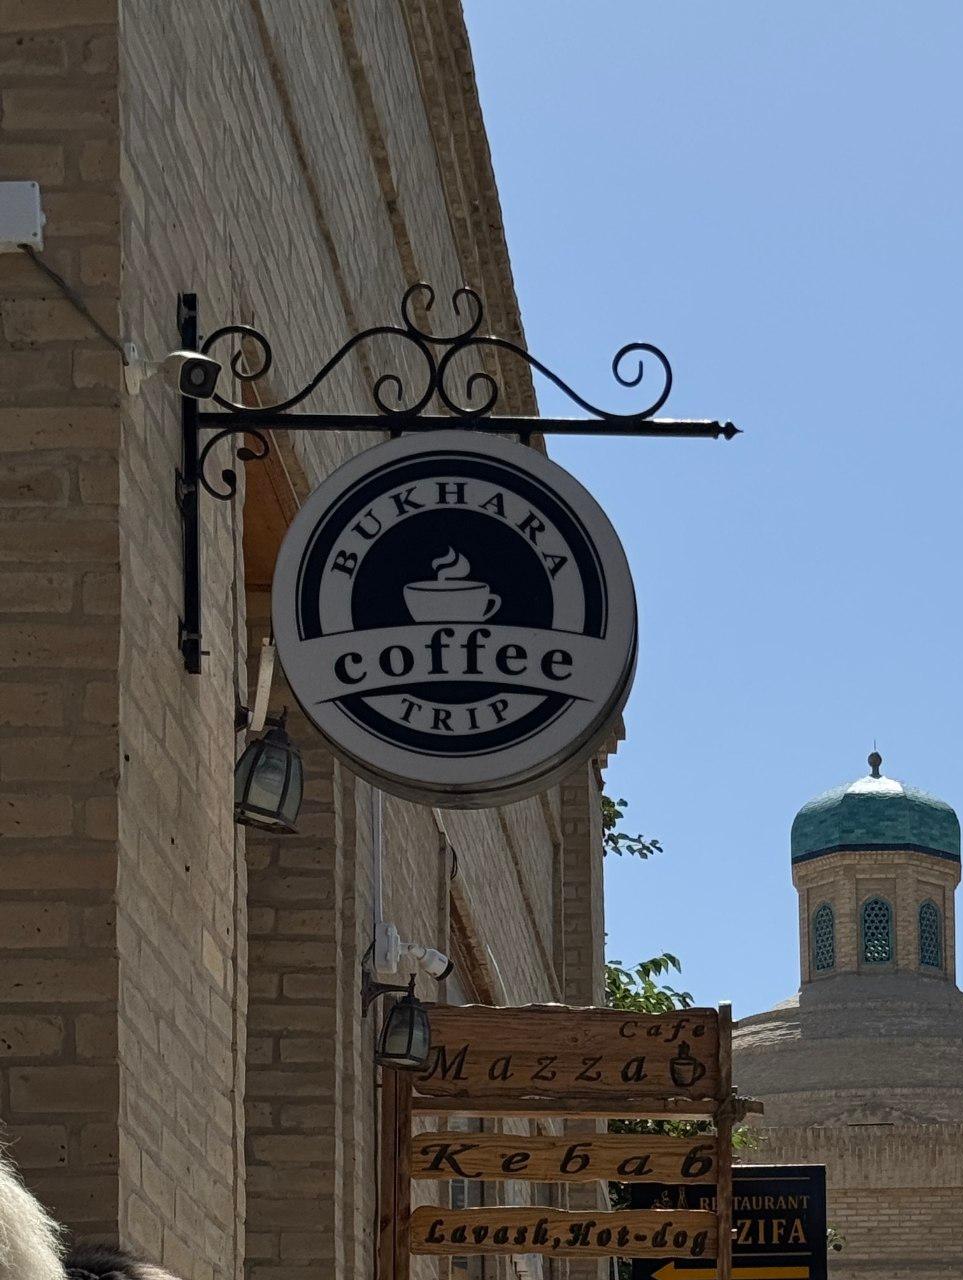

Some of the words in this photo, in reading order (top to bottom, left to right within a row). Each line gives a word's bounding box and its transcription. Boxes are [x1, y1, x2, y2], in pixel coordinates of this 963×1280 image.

[331, 482, 568, 580] BUKHARA
[333, 627, 573, 685] coffee
[399, 698, 510, 732] TRIP
[618, 1018, 707, 1042] Cafe
[418, 1043, 648, 1082] Mazza
[699, 1195, 810, 1211] RTAURANT
[737, 1218, 807, 1246] ZIFA
